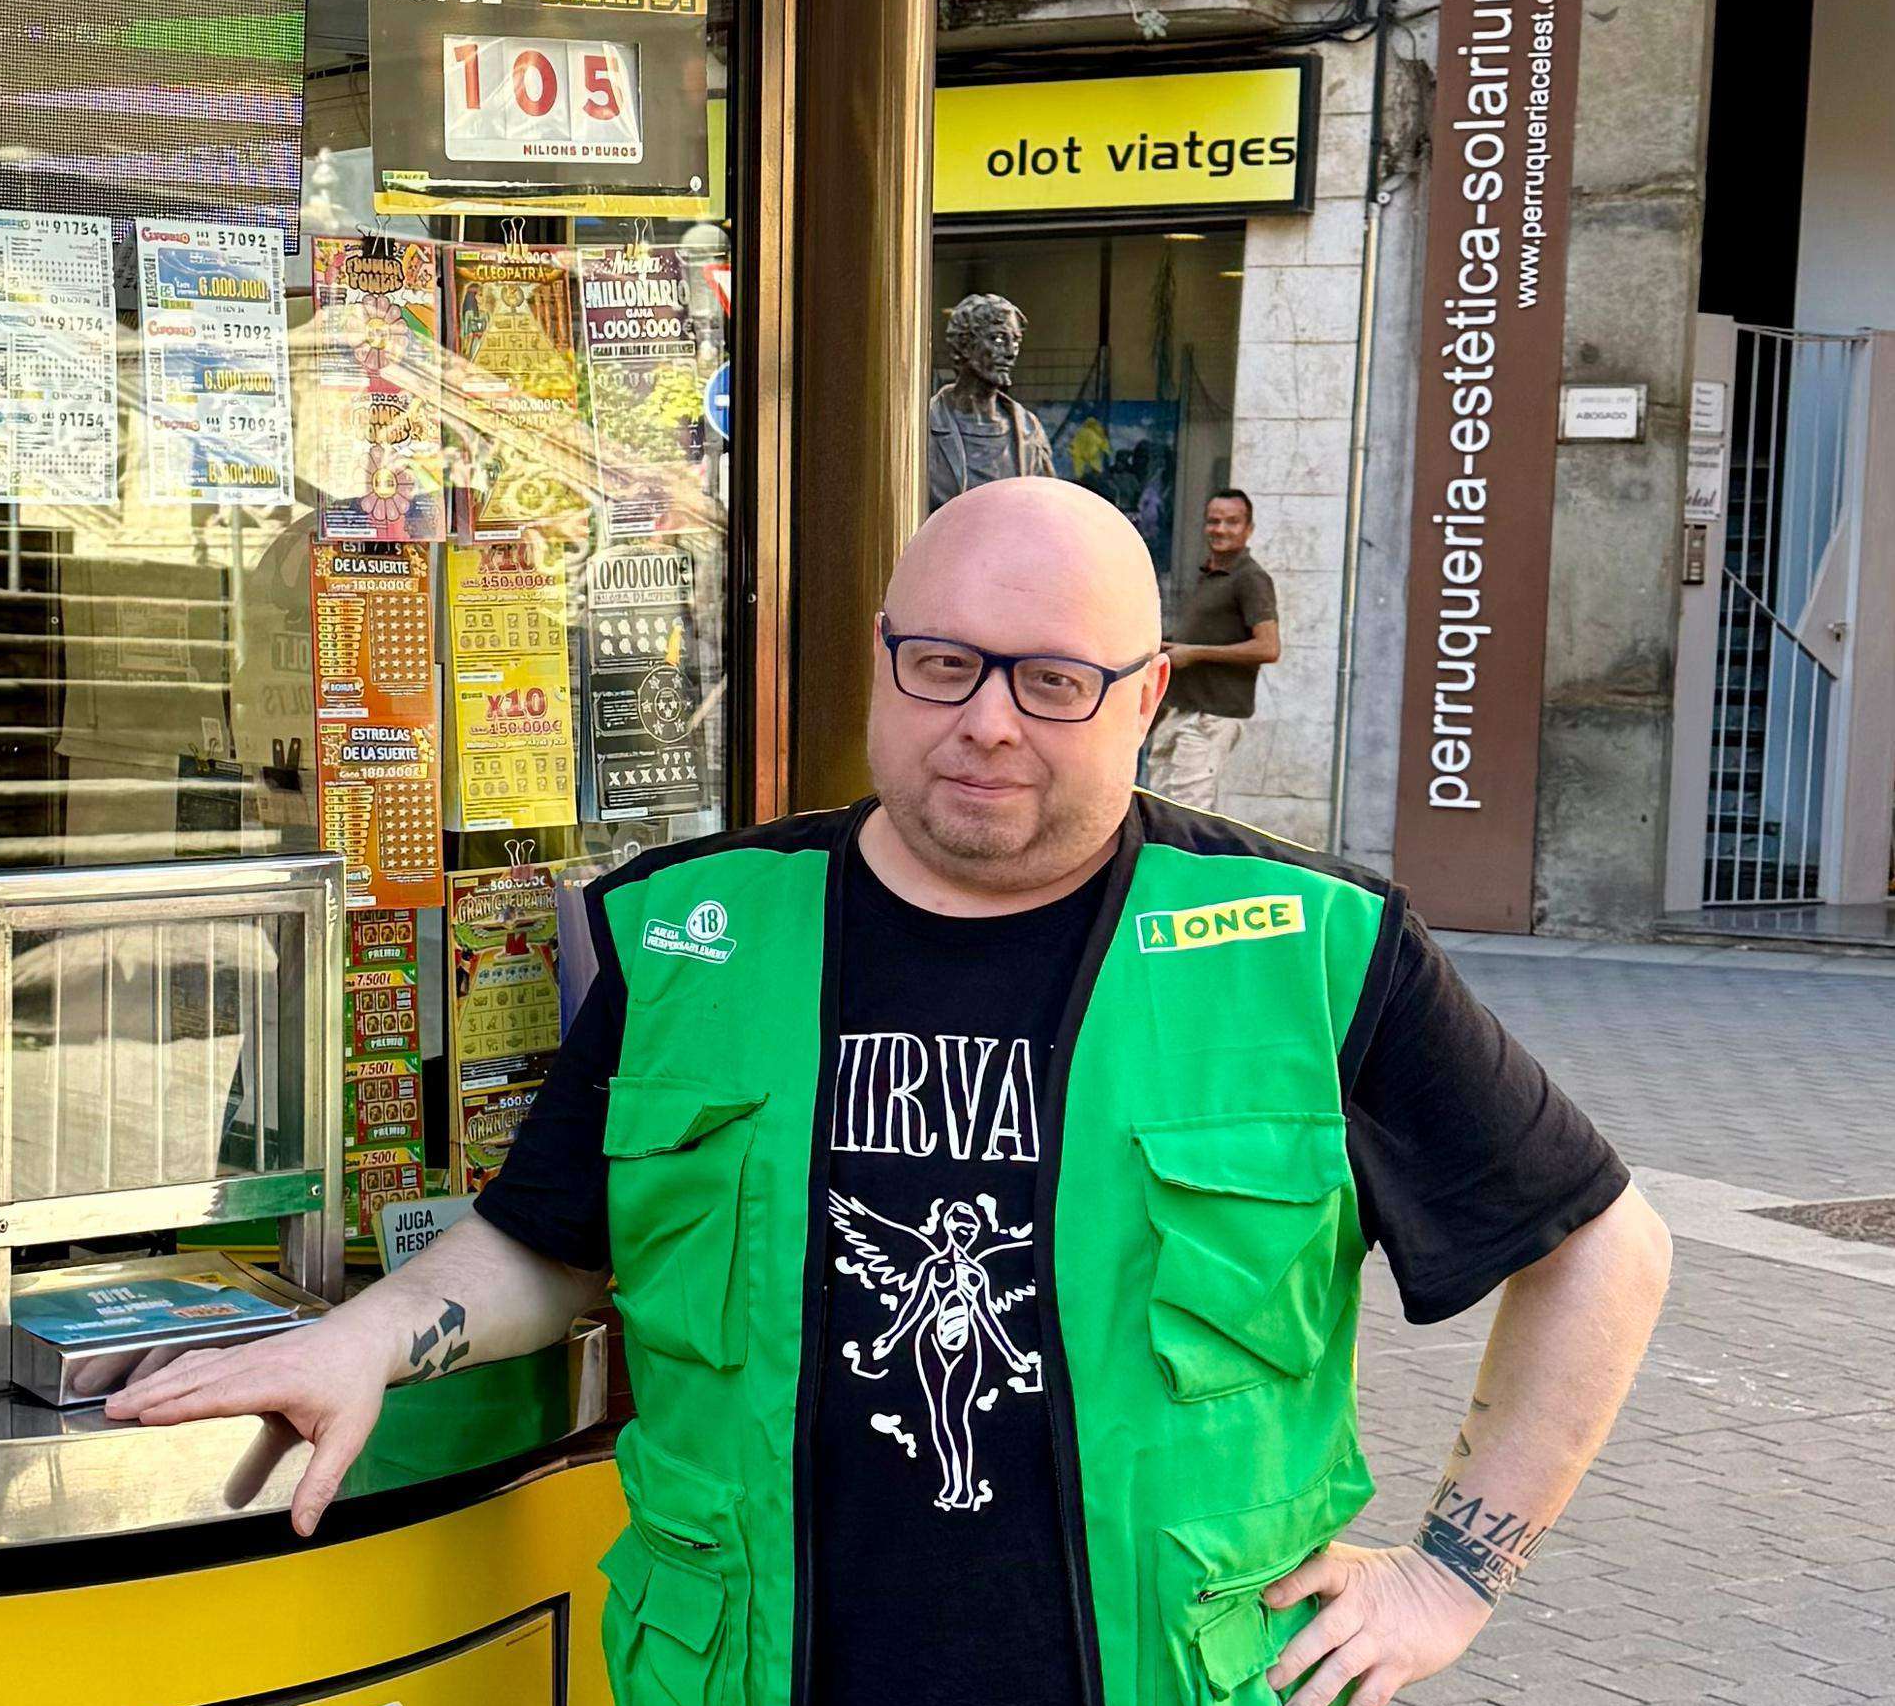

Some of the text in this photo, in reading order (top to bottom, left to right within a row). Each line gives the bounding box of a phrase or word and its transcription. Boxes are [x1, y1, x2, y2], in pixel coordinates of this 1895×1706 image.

[523, 143, 637, 158] MILIONS D'EUROS
[986, 131, 1296, 178] olot viatges
[218, 232, 266, 247] 57092
[477, 265, 549, 281] CLEOPATRA
[586, 279, 690, 308] MILLONARIO
[626, 308, 654, 318] GANA
[224, 324, 271, 339] 57092
[60, 412, 104, 427] 91754
[1576, 412, 1627, 420] ABOGADO
[229, 417, 275, 432] 57092
[335, 558, 409, 575] DE LA SUERTE
[487, 687, 547, 717] x10
[351, 727, 410, 742] ESTRELLAS
[490, 720, 562, 734] 150.000€
[343, 746, 418, 761] DE LA SUERTE
[457, 897, 492, 921] GRAN
[1184, 902, 1292, 941] ONCE
[368, 949, 401, 959] PREMIO
[371, 1038, 403, 1048] PREMIO
[373, 1125, 406, 1138] PREMIO
[468, 1116, 500, 1144] GRAN
[395, 1210, 433, 1233] JUGA
